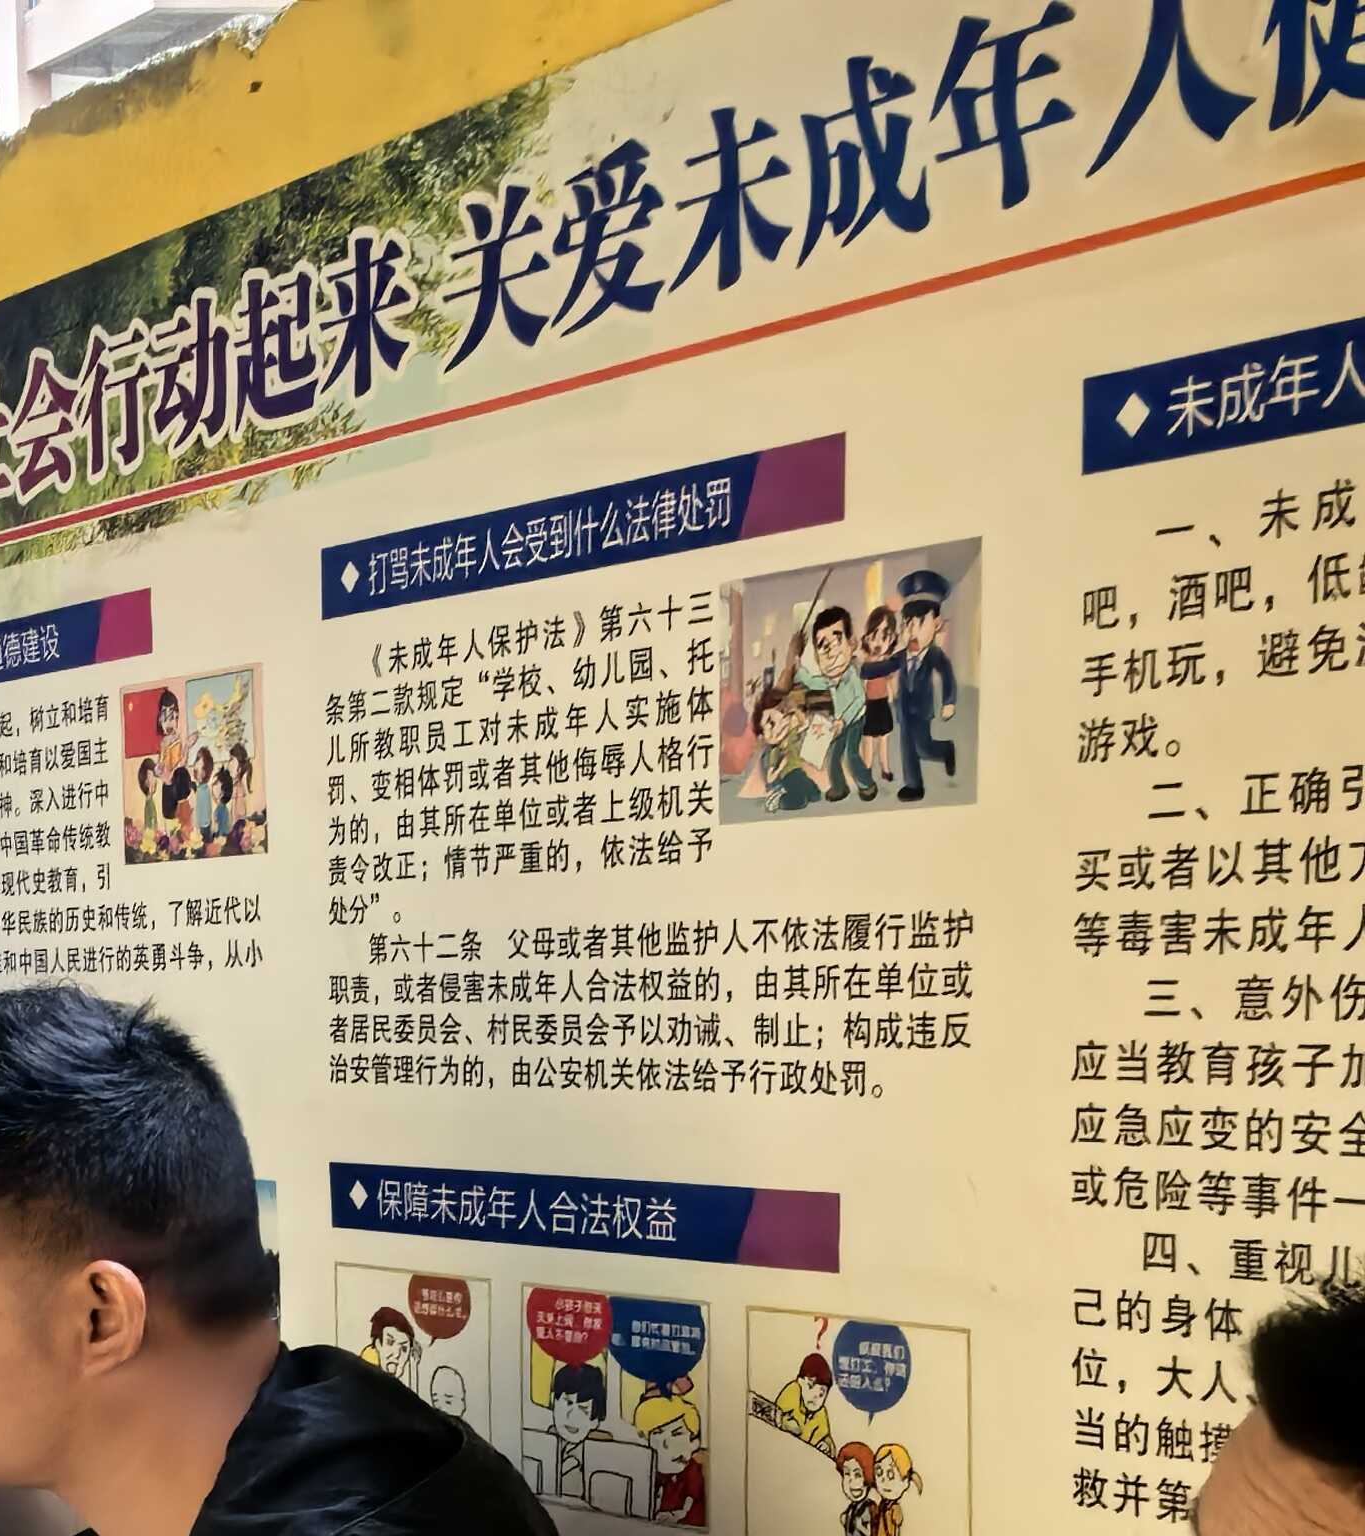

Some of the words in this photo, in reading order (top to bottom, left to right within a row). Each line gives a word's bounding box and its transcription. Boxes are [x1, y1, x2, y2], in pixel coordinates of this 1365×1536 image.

[1167, 340, 1365, 438] 未成年人
[368, 476, 733, 597] 打骂未成年人会受到什么法律处罚
[1155, 478, 1358, 547] 一、未成
[1081, 551, 1365, 630] 吧，酒吧，低
[371, 589, 715, 679] 《未成年人保护法》第六十三
[1079, 622, 1365, 698] 手机玩，避免
[326, 686, 715, 766] 儿所教职员工对未成年人实施体
[1077, 712, 1182, 764] 游戏。
[327, 733, 715, 806] 罚、变相体罚或者其他侮辱人格行
[327, 780, 714, 846] 为的，由其所在单位或者上级机关
[328, 826, 714, 887] 责令改正；情节严重的，依法给予
[368, 931, 483, 966] 第六十二条
[507, 908, 975, 962] 父母或者其他监护人不依法履行监护
[329, 960, 974, 1007] 职责，或者侵害未成年人合法权益的，由其所在单位或
[328, 1011, 973, 1051] 者居民委员会、村民委员会予以劝诫、制止；构成违反
[328, 1053, 886, 1099] 治安管理行为的，由公安机关依法给予行政处罚。
[1070, 1102, 1365, 1158] 应急应变的安全
[376, 1178, 679, 1243] 保障未成年人合法权益
[1072, 1287, 1243, 1343] 己的身体
[1072, 1467, 1192, 1524] 救并第
